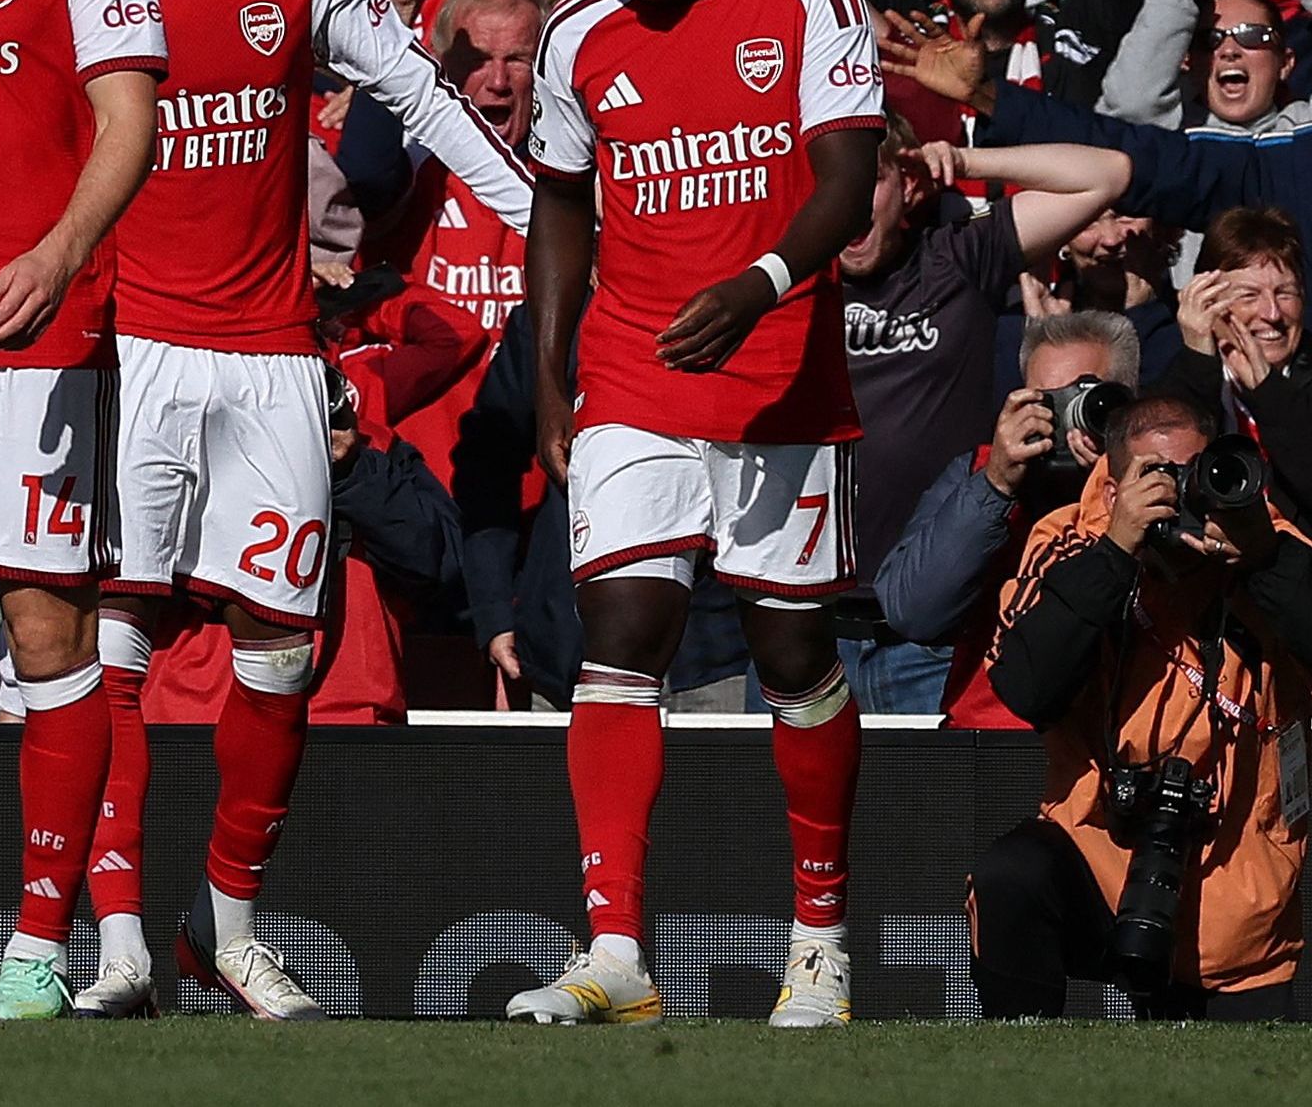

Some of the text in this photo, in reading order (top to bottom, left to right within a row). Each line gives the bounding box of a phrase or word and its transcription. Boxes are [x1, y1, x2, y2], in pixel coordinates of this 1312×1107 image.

[742, 48, 778, 59] Arsenal
[184, 128, 267, 169] BETTER
[609, 121, 793, 180] Emirates
[634, 166, 768, 216] FLY BETTER
[427, 254, 525, 295] Emira
[21, 473, 86, 546] 14
[796, 492, 829, 565] 7
[239, 510, 325, 589] 20
[30, 828, 65, 851] AFC
